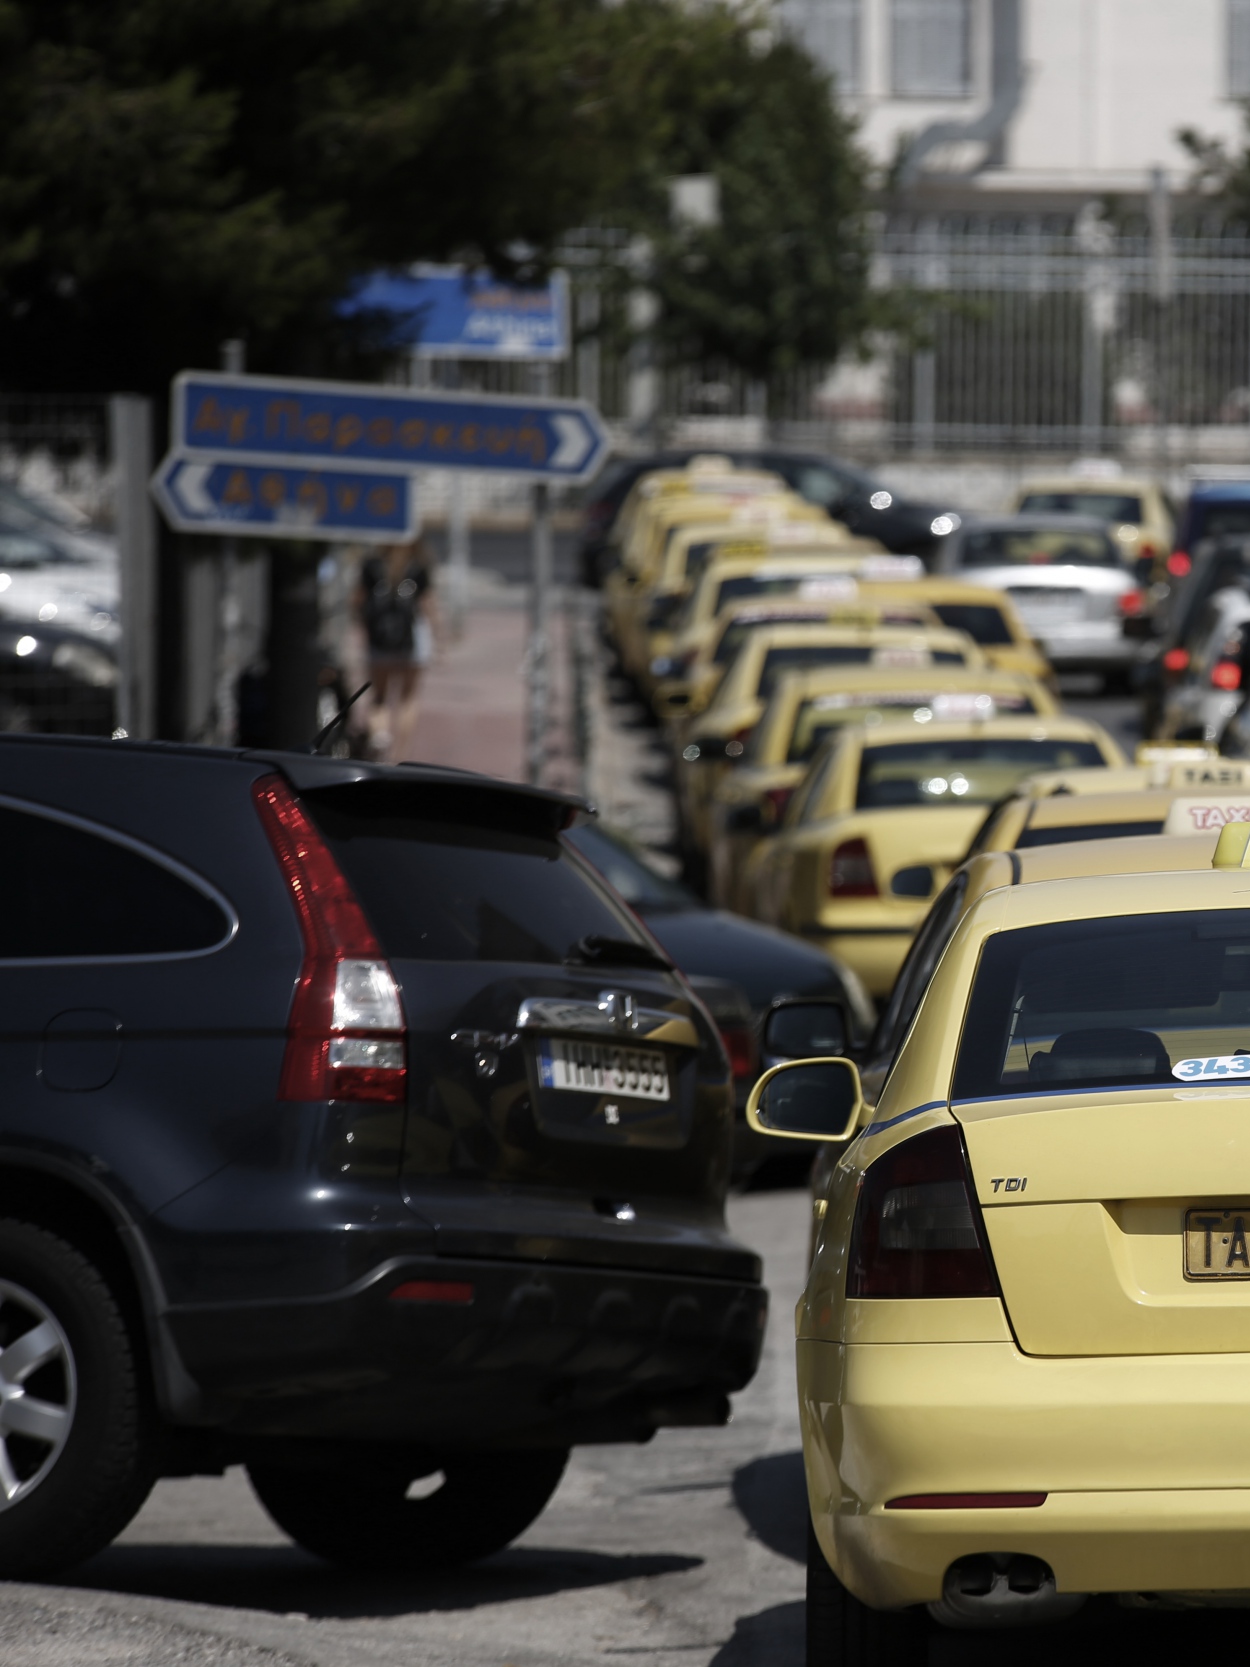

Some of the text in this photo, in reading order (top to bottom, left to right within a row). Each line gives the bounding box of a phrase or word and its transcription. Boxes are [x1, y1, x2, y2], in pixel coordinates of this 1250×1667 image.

[265, 399, 547, 463] Παρασκευή
[221, 468, 397, 518] Αθήνα
[990, 1177, 1028, 1193] TDI
